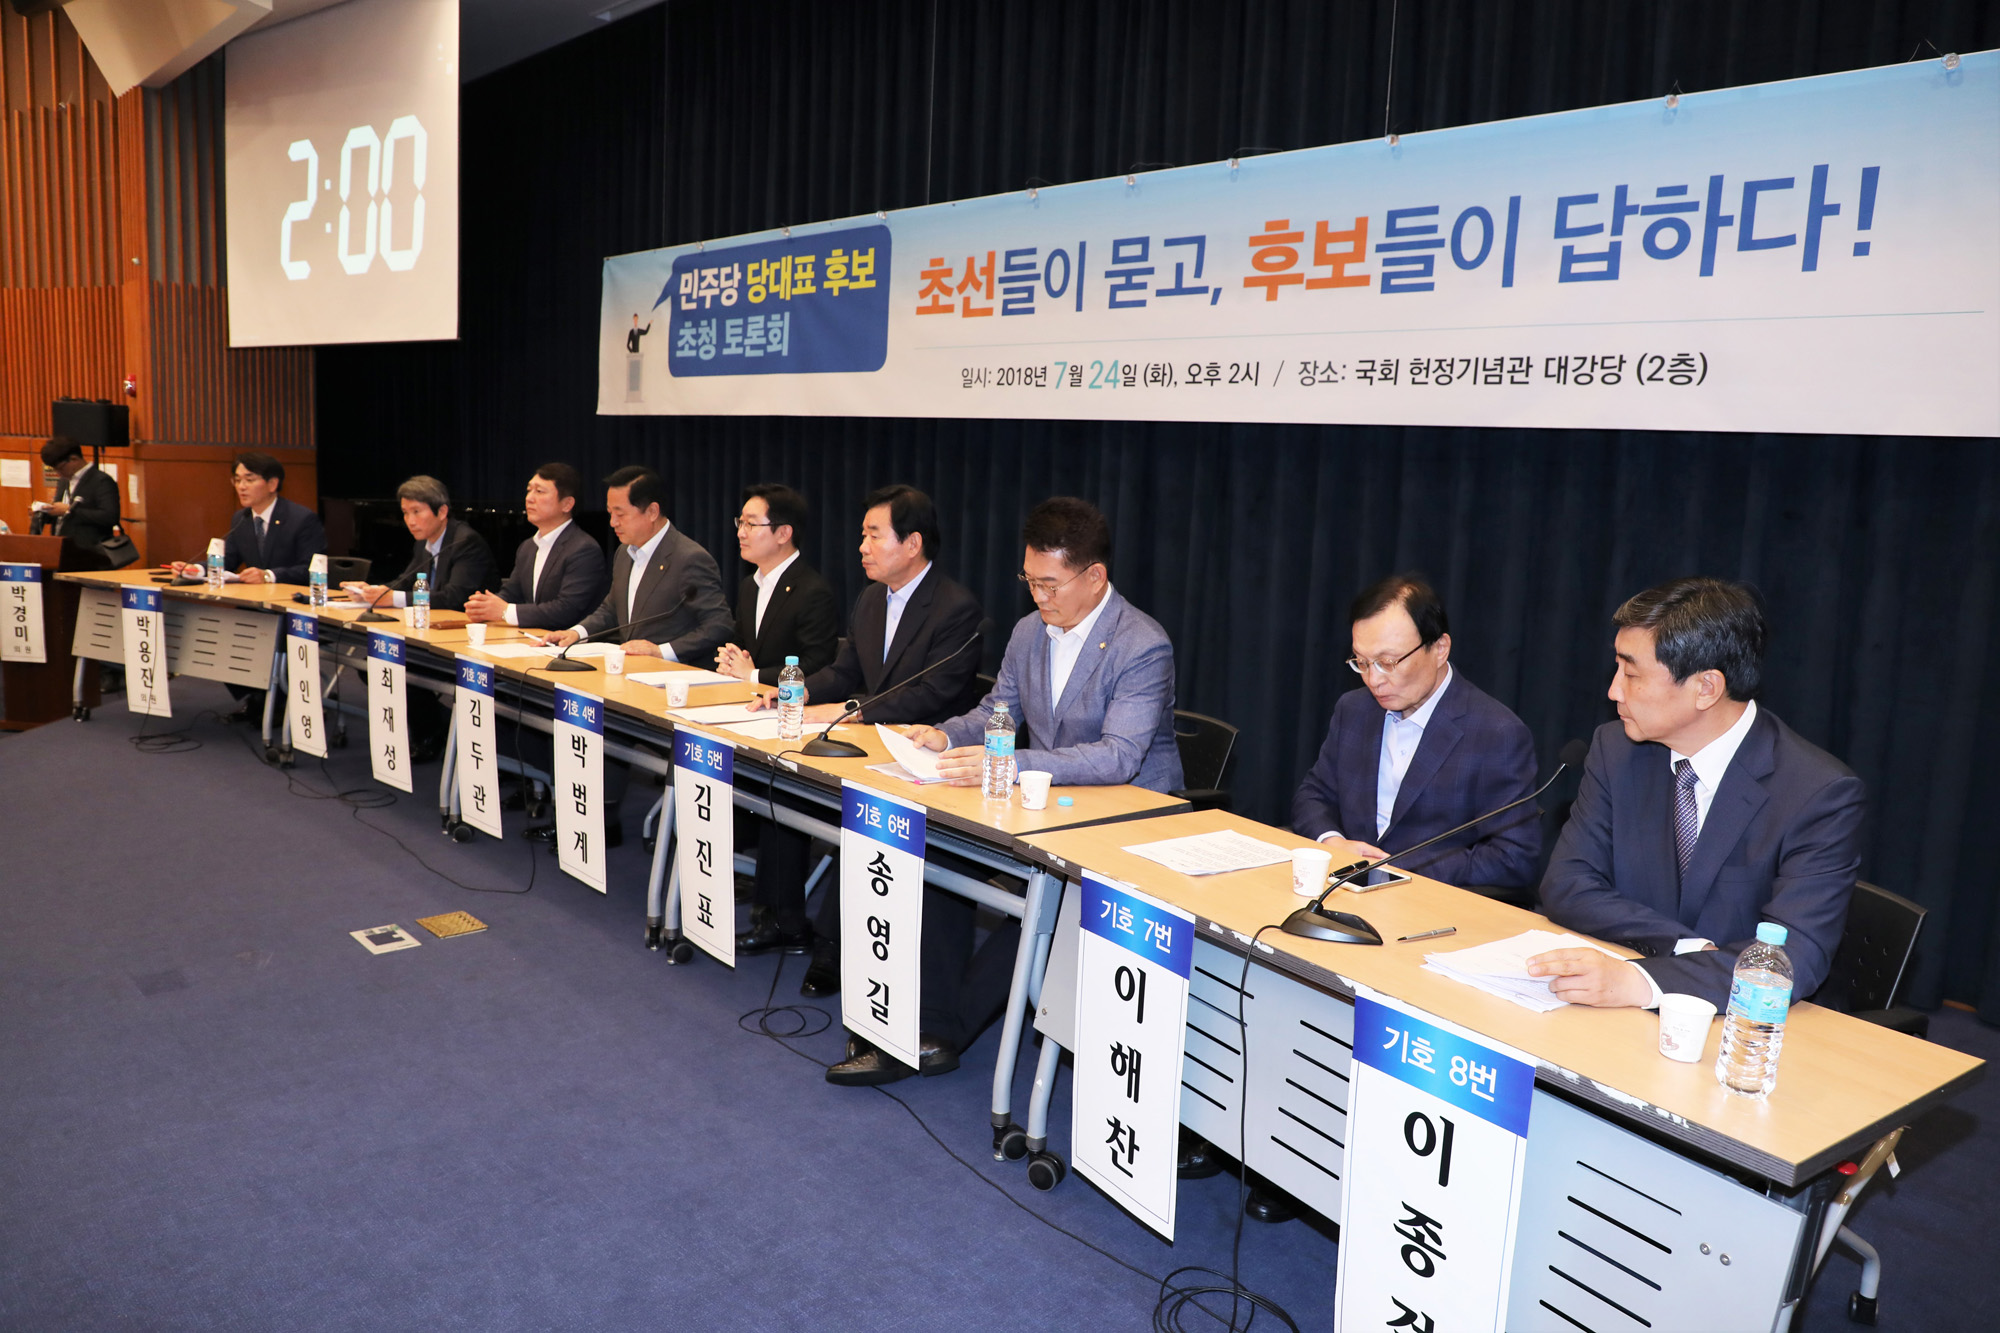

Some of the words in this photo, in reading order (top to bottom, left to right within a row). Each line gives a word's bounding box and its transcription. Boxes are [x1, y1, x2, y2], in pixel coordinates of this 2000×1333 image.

[280, 114, 428, 281] 2:00
[915, 240, 1087, 318] 초선들이
[1104, 234, 1223, 310] 묻고,
[1242, 195, 1522, 302] 후보들이
[1553, 163, 1881, 284] 답하다!
[679, 262, 742, 311] 민주당
[746, 254, 817, 304] 당대표
[823, 247, 877, 297] 후보
[675, 317, 717, 361] 초청
[722, 311, 790, 358] 토론회
[961, 366, 992, 389] 일시:
[996, 365, 1048, 388] 2018년
[1053, 360, 1084, 390] 7월
[1088, 359, 1138, 390] 24일
[1143, 361, 1178, 389] (화),
[1184, 361, 1222, 388] 오후
[1228, 360, 1260, 388] 2시
[1298, 359, 1346, 388] 장소:
[1355, 358, 1400, 387] 국회
[1408, 355, 1533, 387] 헌정기념관
[1544, 353, 1627, 386] 대강당
[1636, 352, 1709, 387] (2층)
[374, 639, 387, 653] 기호
[388, 643, 400, 658] 2번
[462, 666, 475, 684] 기호
[477, 671, 488, 688] 3번
[562, 698, 579, 718] 기호
[582, 705, 596, 724] 4번
[684, 742, 704, 763] 기호
[707, 749, 723, 772] 5번
[855, 801, 883, 830] 기호
[887, 812, 911, 841] 6번
[1099, 898, 1135, 933] 기호
[1143, 917, 1173, 955] 7번
[1381, 1025, 1437, 1075] 기호
[1449, 1055, 1498, 1103] 8번
